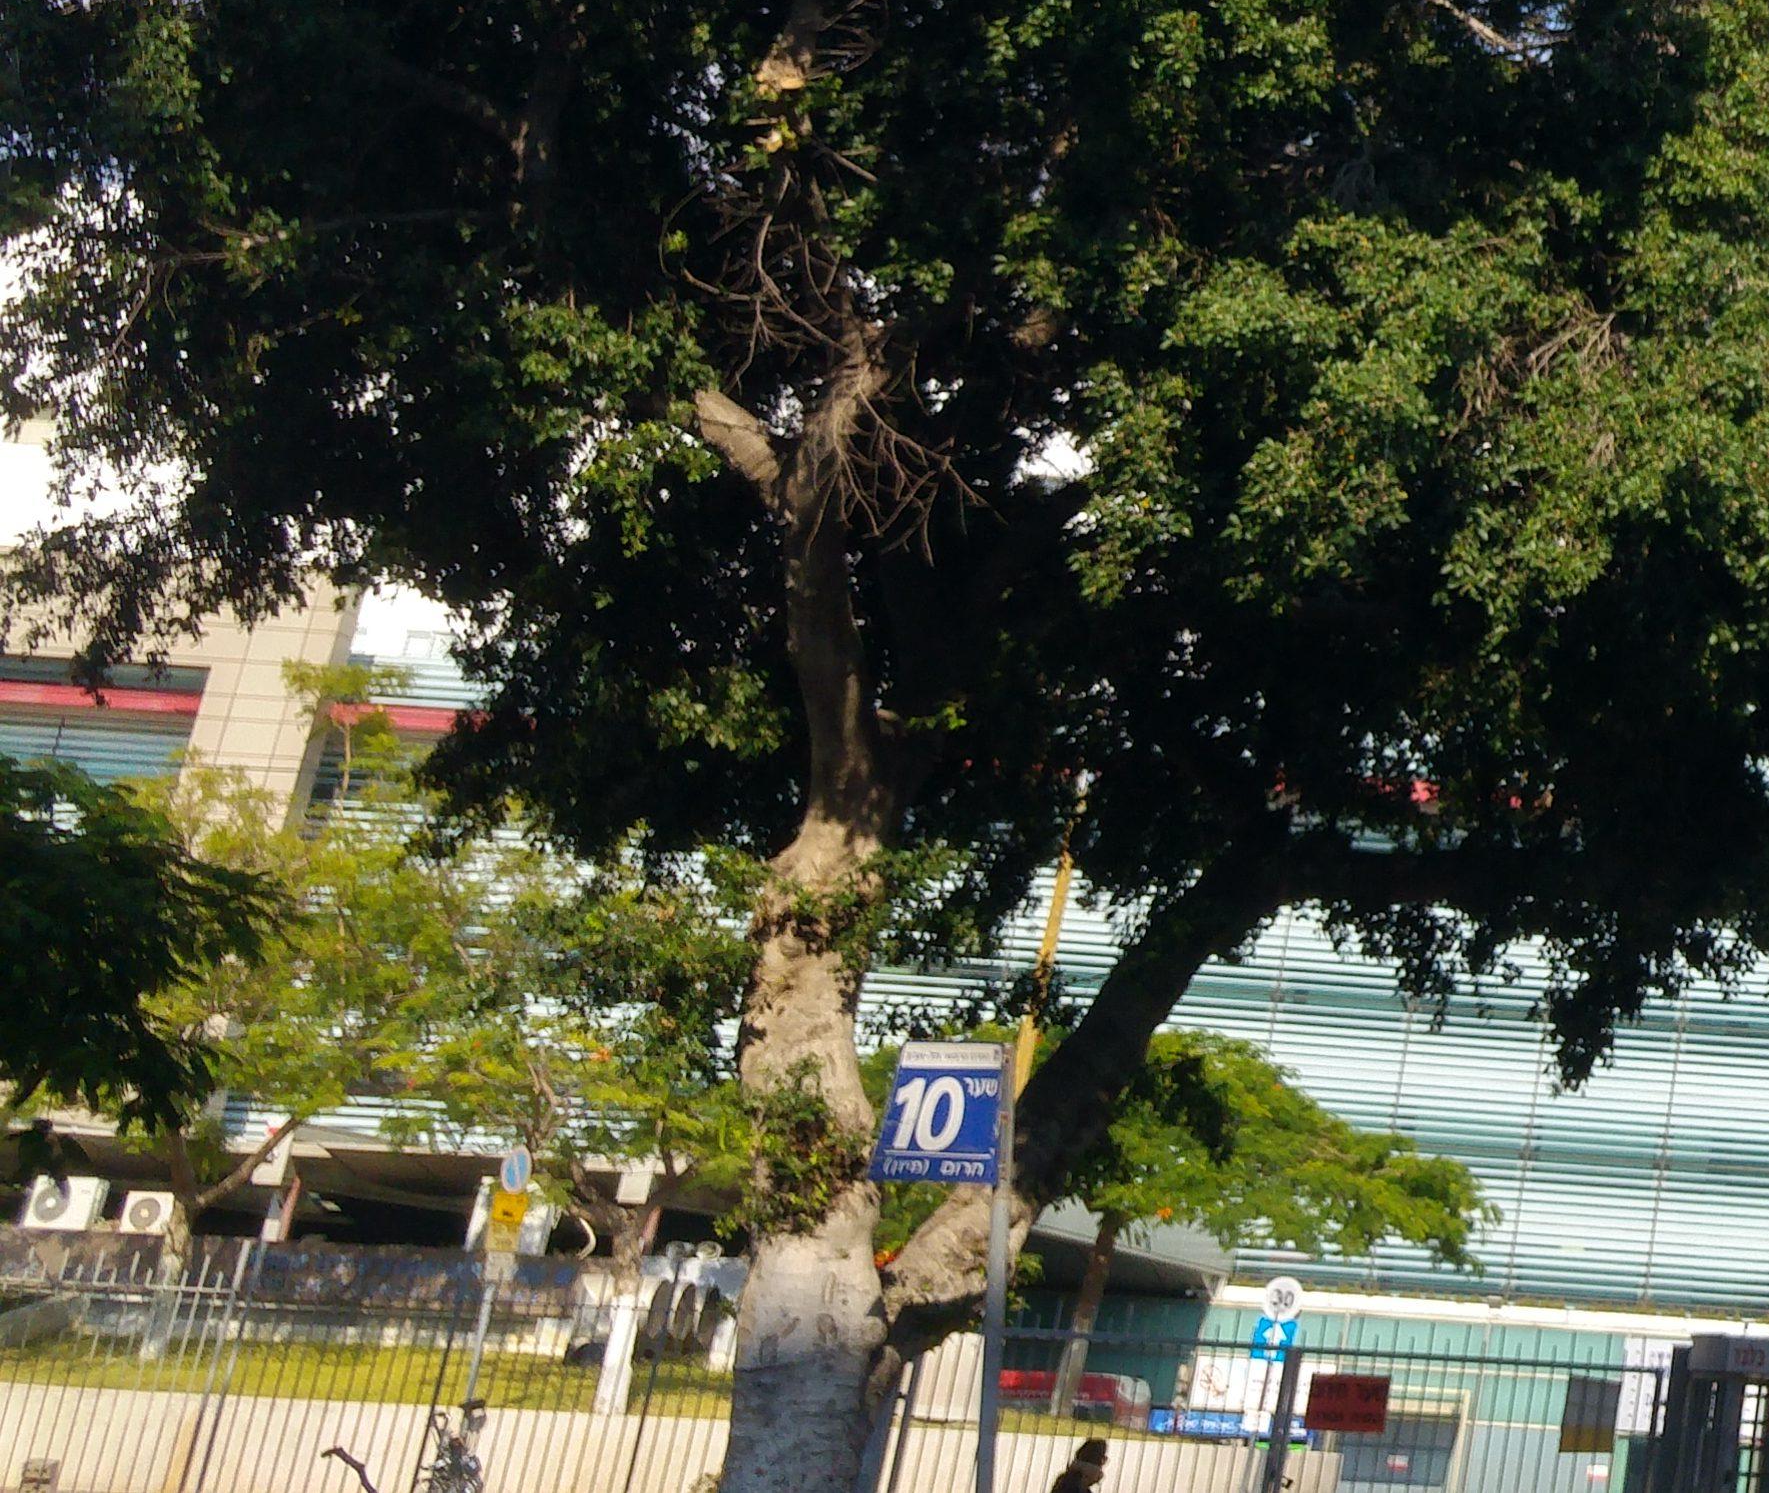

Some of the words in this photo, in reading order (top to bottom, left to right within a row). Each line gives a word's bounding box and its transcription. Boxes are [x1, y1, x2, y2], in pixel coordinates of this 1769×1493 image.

[963, 1077, 998, 1099] שער
[892, 1076, 965, 1152] 10
[939, 1159, 985, 1178] חרום
[1270, 1288, 1295, 1307] 30
